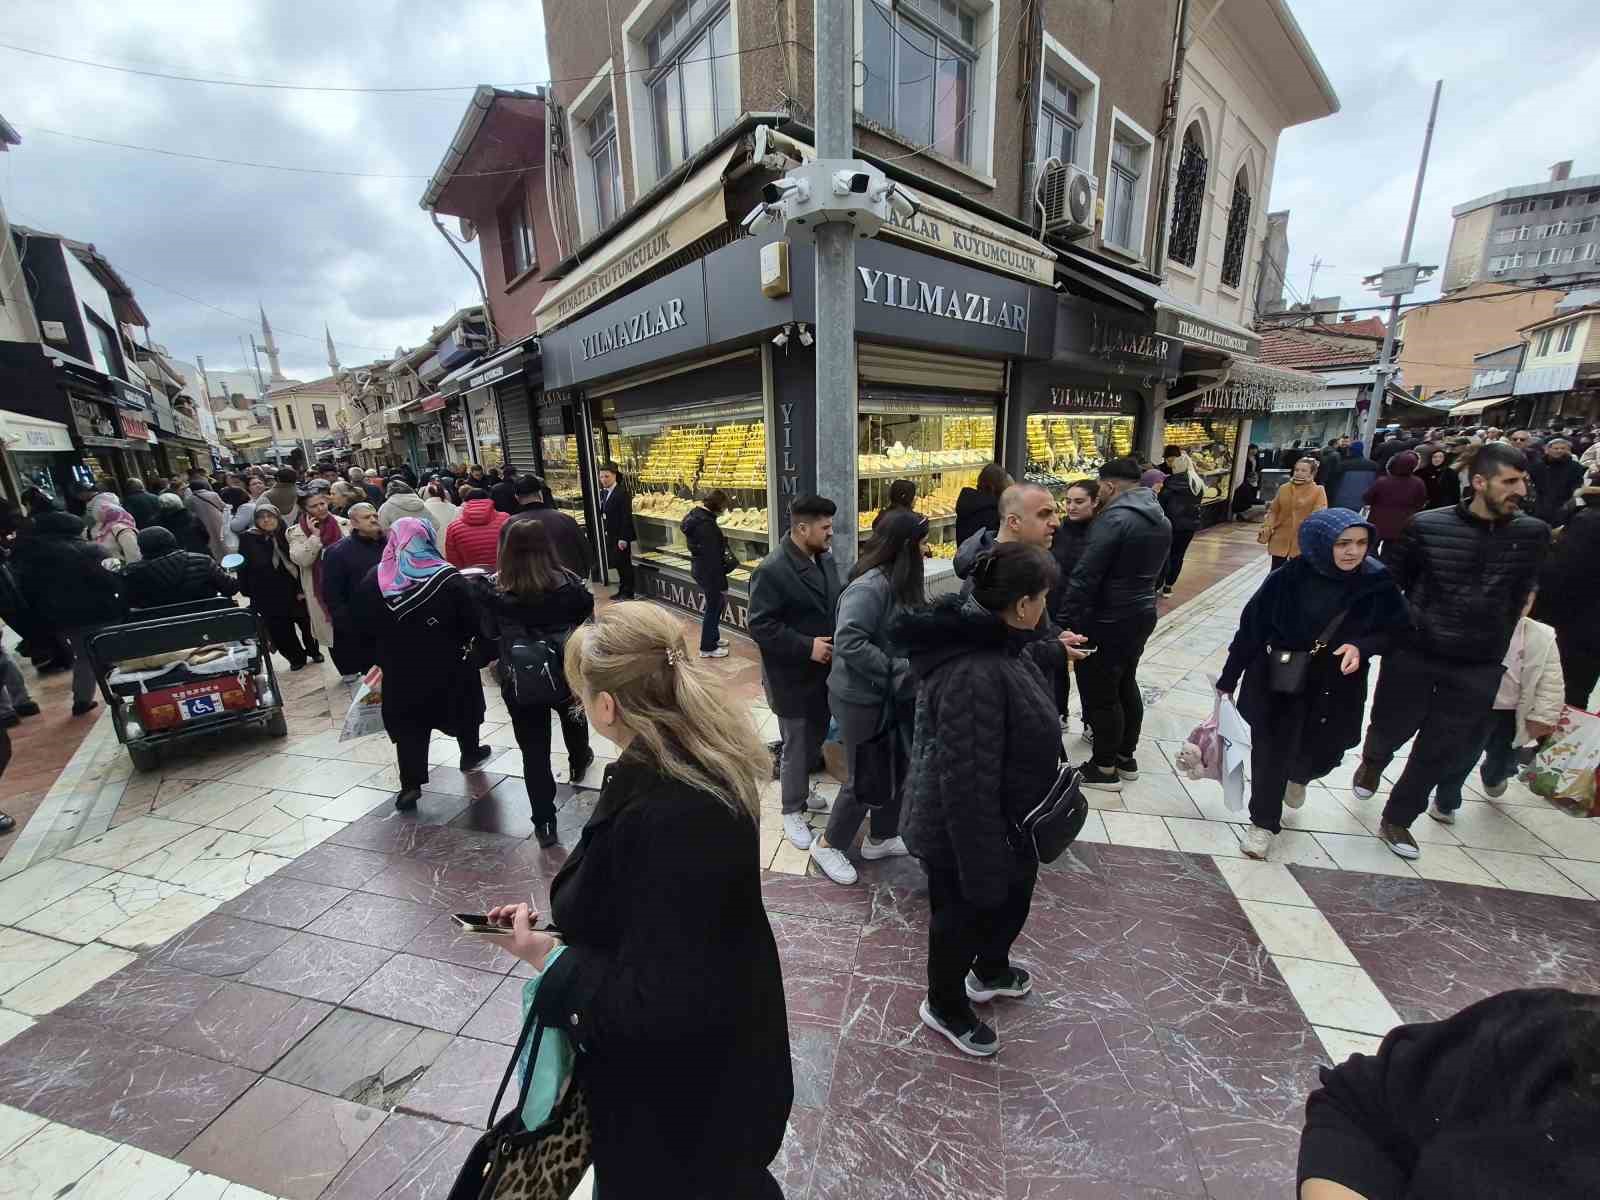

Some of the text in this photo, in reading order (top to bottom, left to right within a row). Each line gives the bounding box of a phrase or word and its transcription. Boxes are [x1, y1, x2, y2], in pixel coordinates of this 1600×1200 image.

[952, 230, 1037, 274] KUYUMCULUK
[857, 266, 1026, 333] YILMAZLAR
[582, 297, 688, 361] YILMAZLAR
[1050, 387, 1122, 409] YILMAZLAR
